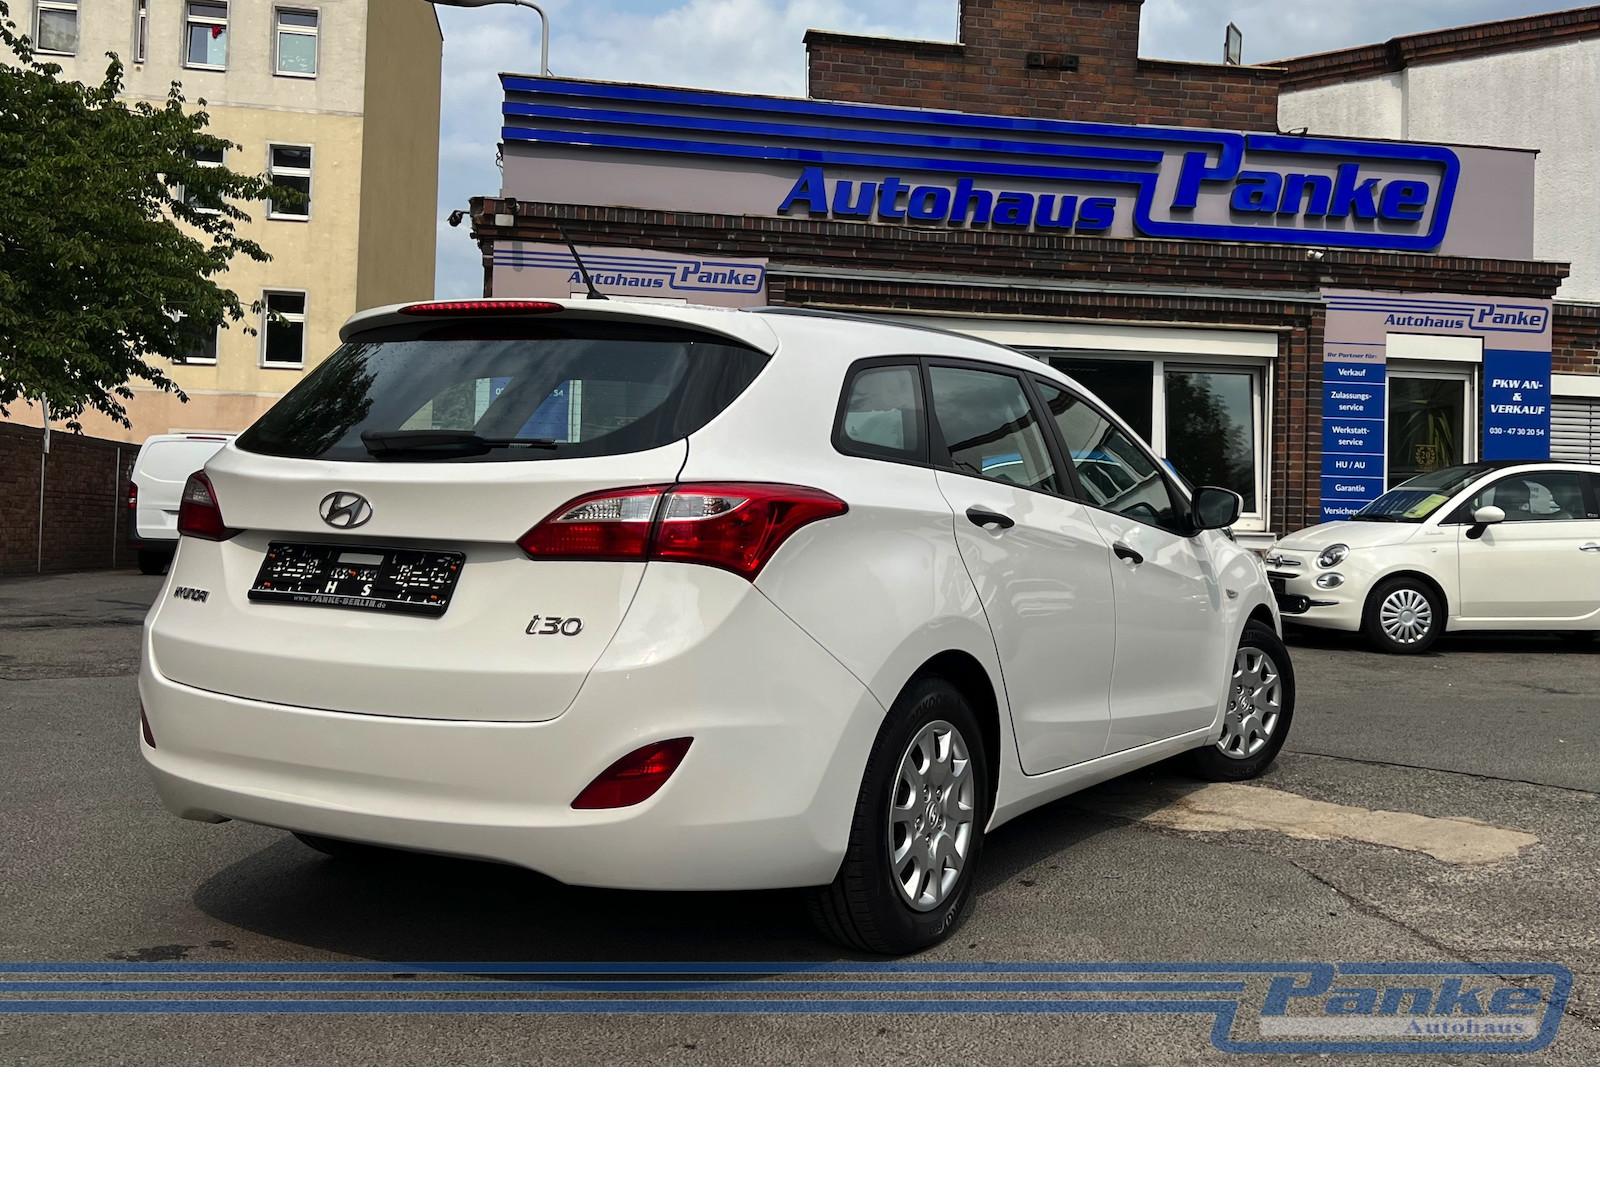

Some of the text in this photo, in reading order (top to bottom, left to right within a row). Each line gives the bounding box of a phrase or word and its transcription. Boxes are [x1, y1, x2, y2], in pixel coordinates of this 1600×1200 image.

[777, 133, 1430, 231] Autohaus Panke
[680, 262, 757, 286] Panke
[1384, 304, 1542, 329] Autohaus Panke
[1337, 368, 1367, 377] Verkauf
[1492, 379, 1544, 390] PKW AN-
[1331, 391, 1372, 401] Zulassungs-
[1512, 392, 1522, 401] &
[1338, 403, 1364, 411] service
[1490, 404, 1546, 415] VERKAUF
[1331, 426, 1370, 435] Werkstatt-
[1489, 427, 1503, 435] 030
[1507, 427, 1516, 435] 47
[1516, 428, 1526, 436] 30
[1526, 428, 1535, 436] 20
[1535, 428, 1545, 437] 54
[1338, 438, 1364, 446] service
[1335, 461, 1348, 469] HU
[1354, 461, 1366, 469] AU
[1334, 484, 1366, 492] Garantie
[324, 580, 374, 597] H S
[173, 586, 210, 603] HYUNDAI
[524, 613, 585, 637] i30
